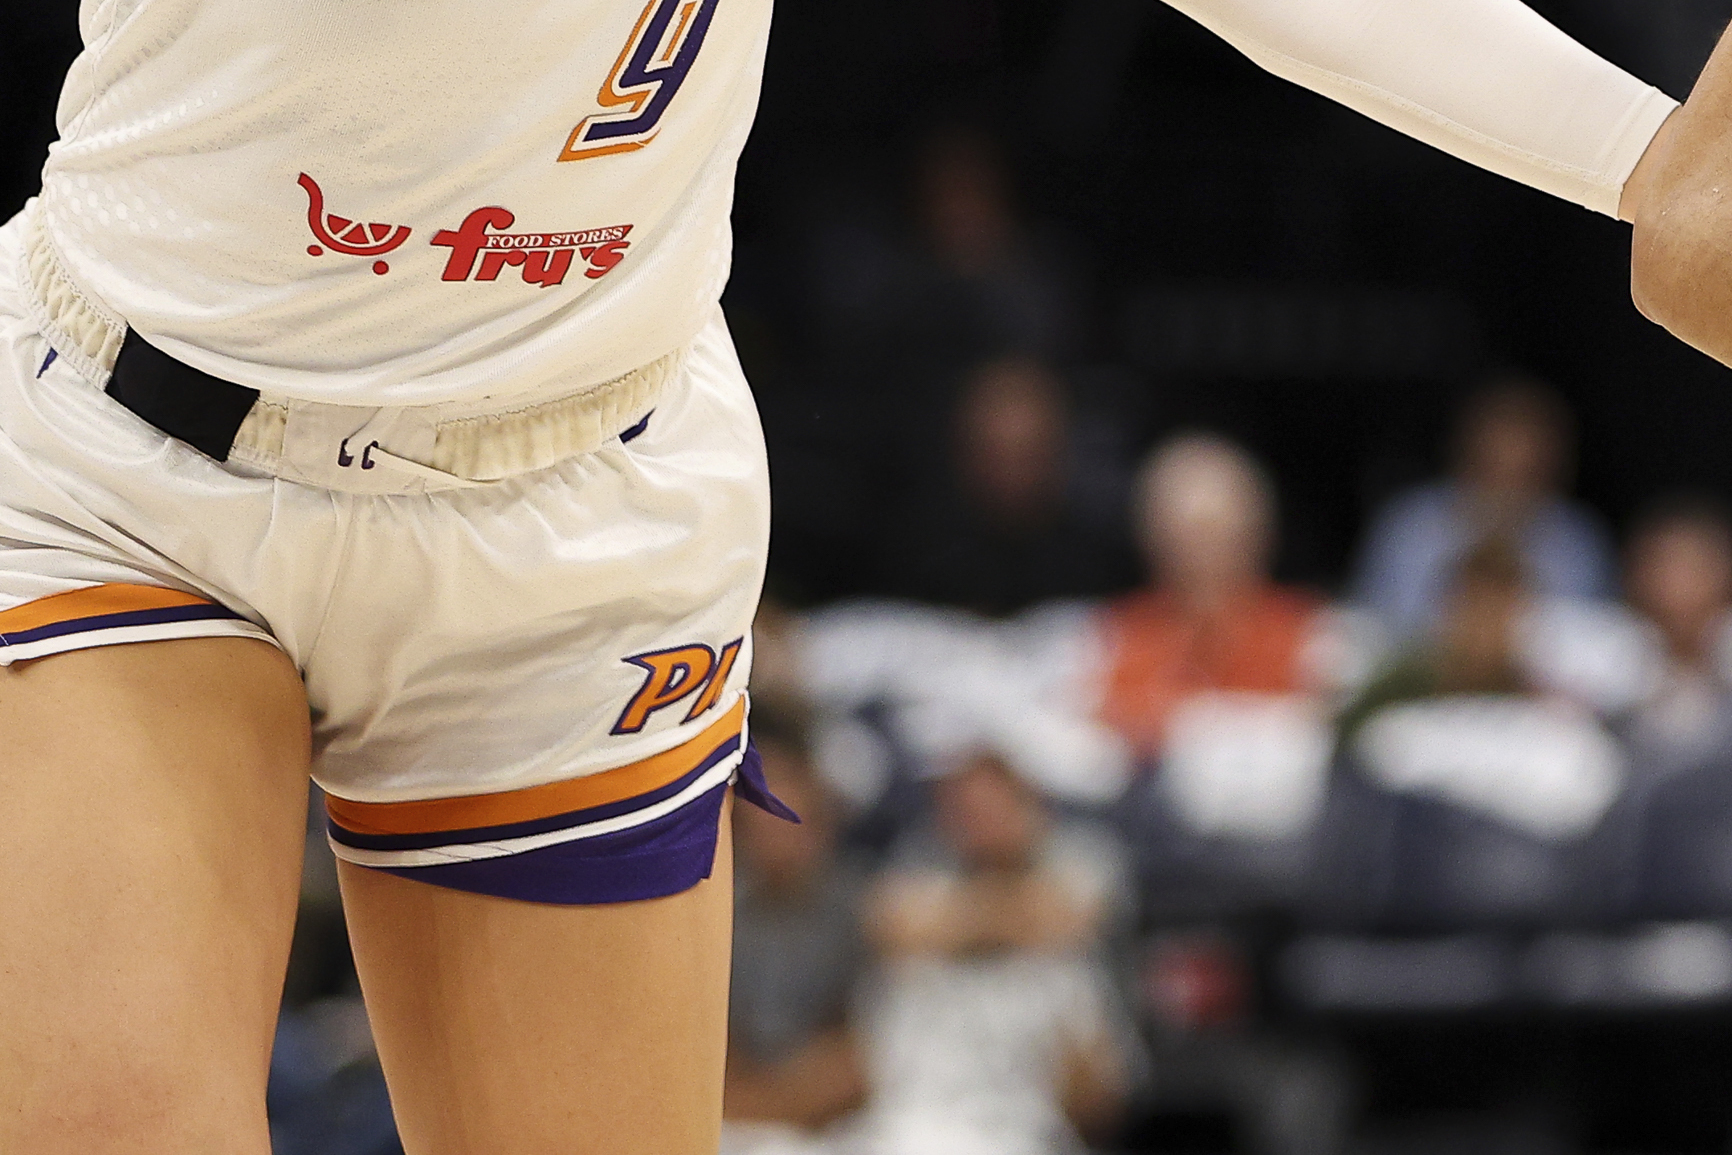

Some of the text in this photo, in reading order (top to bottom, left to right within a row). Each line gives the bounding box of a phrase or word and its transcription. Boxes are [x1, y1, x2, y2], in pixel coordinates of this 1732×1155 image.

[430, 206, 631, 288] fry's
[485, 227, 625, 249] FOOD STORES
